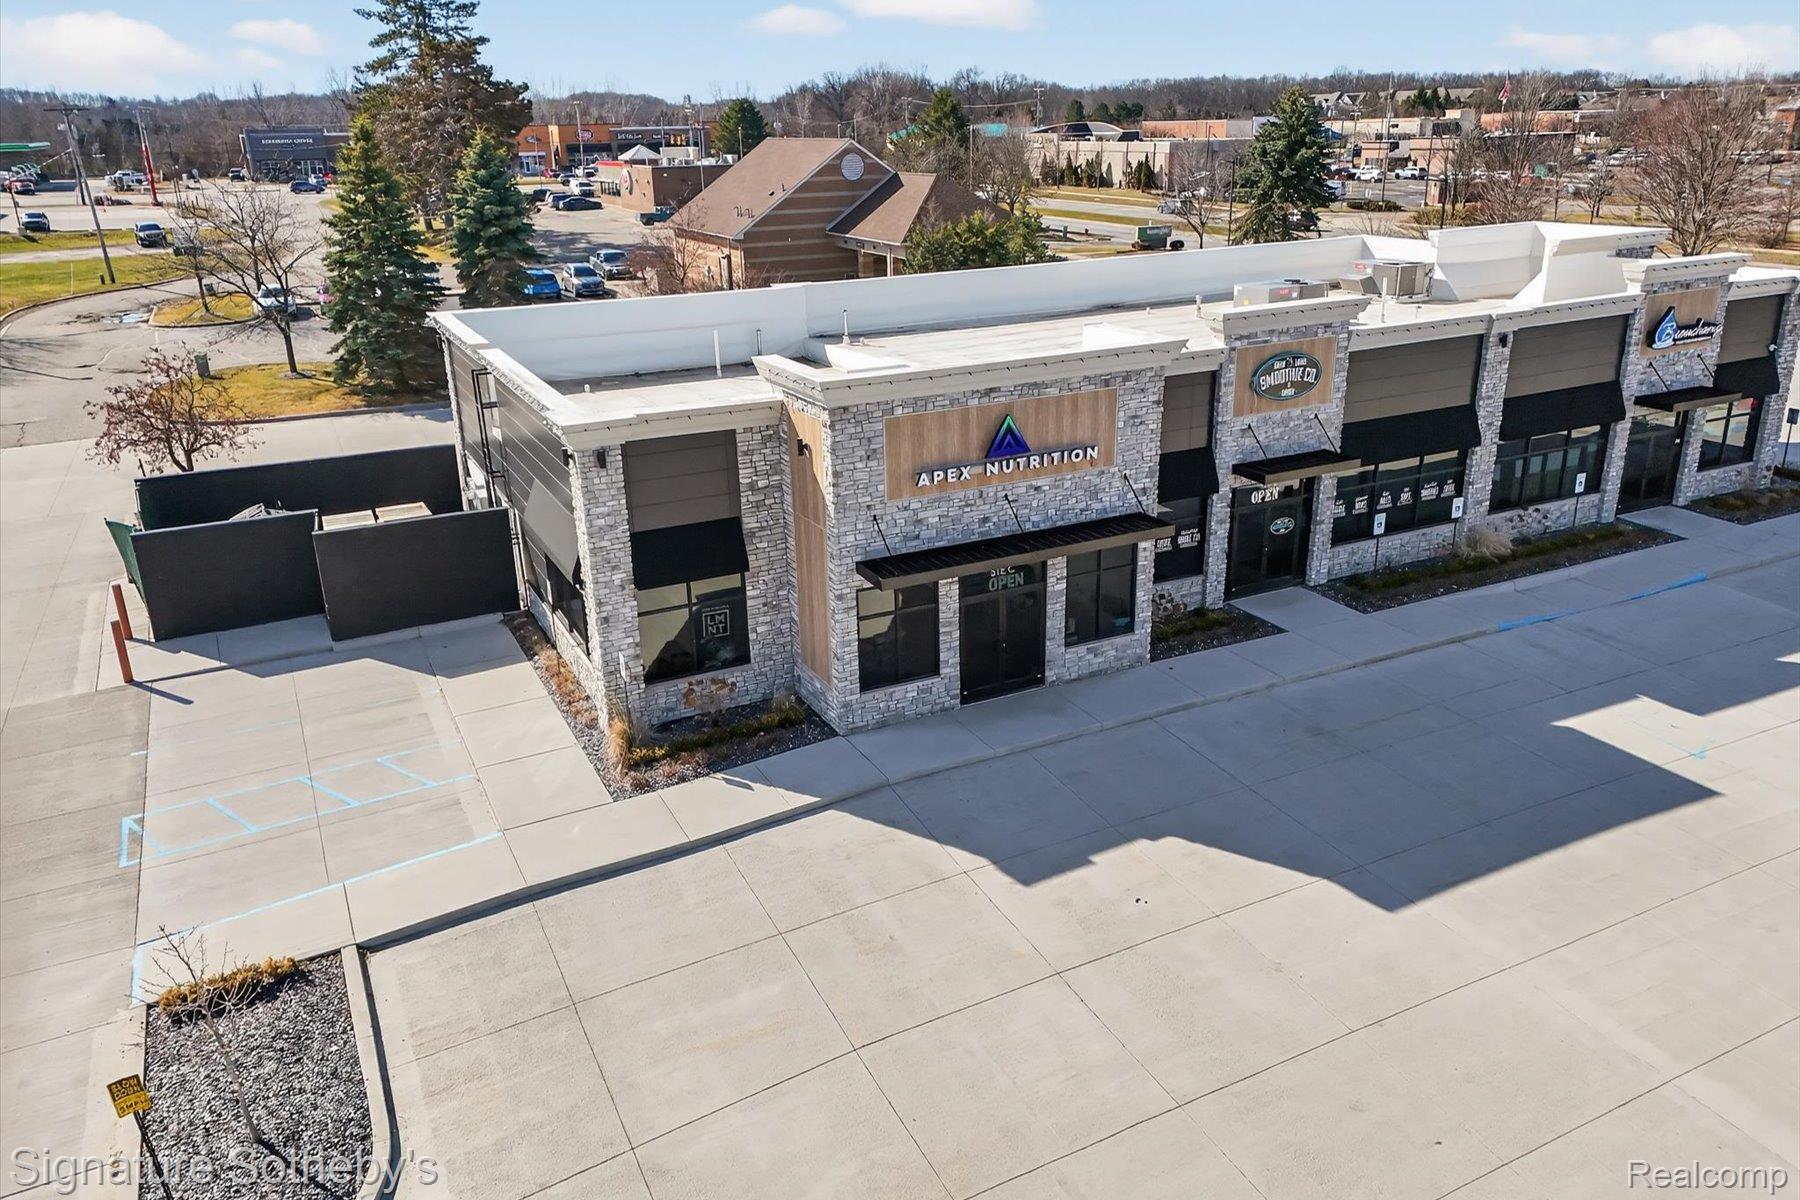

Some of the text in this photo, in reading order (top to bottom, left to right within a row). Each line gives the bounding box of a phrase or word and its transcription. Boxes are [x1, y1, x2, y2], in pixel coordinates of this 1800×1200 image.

[1259, 368, 1303, 390] SMOOTHIE
[916, 445, 1099, 488] APEX NUTRITION
[1251, 486, 1279, 504] OPEN
[988, 572, 1024, 591] OPEN
[110, 1077, 137, 1093] SLOW
[114, 1085, 141, 1100] DOWN
